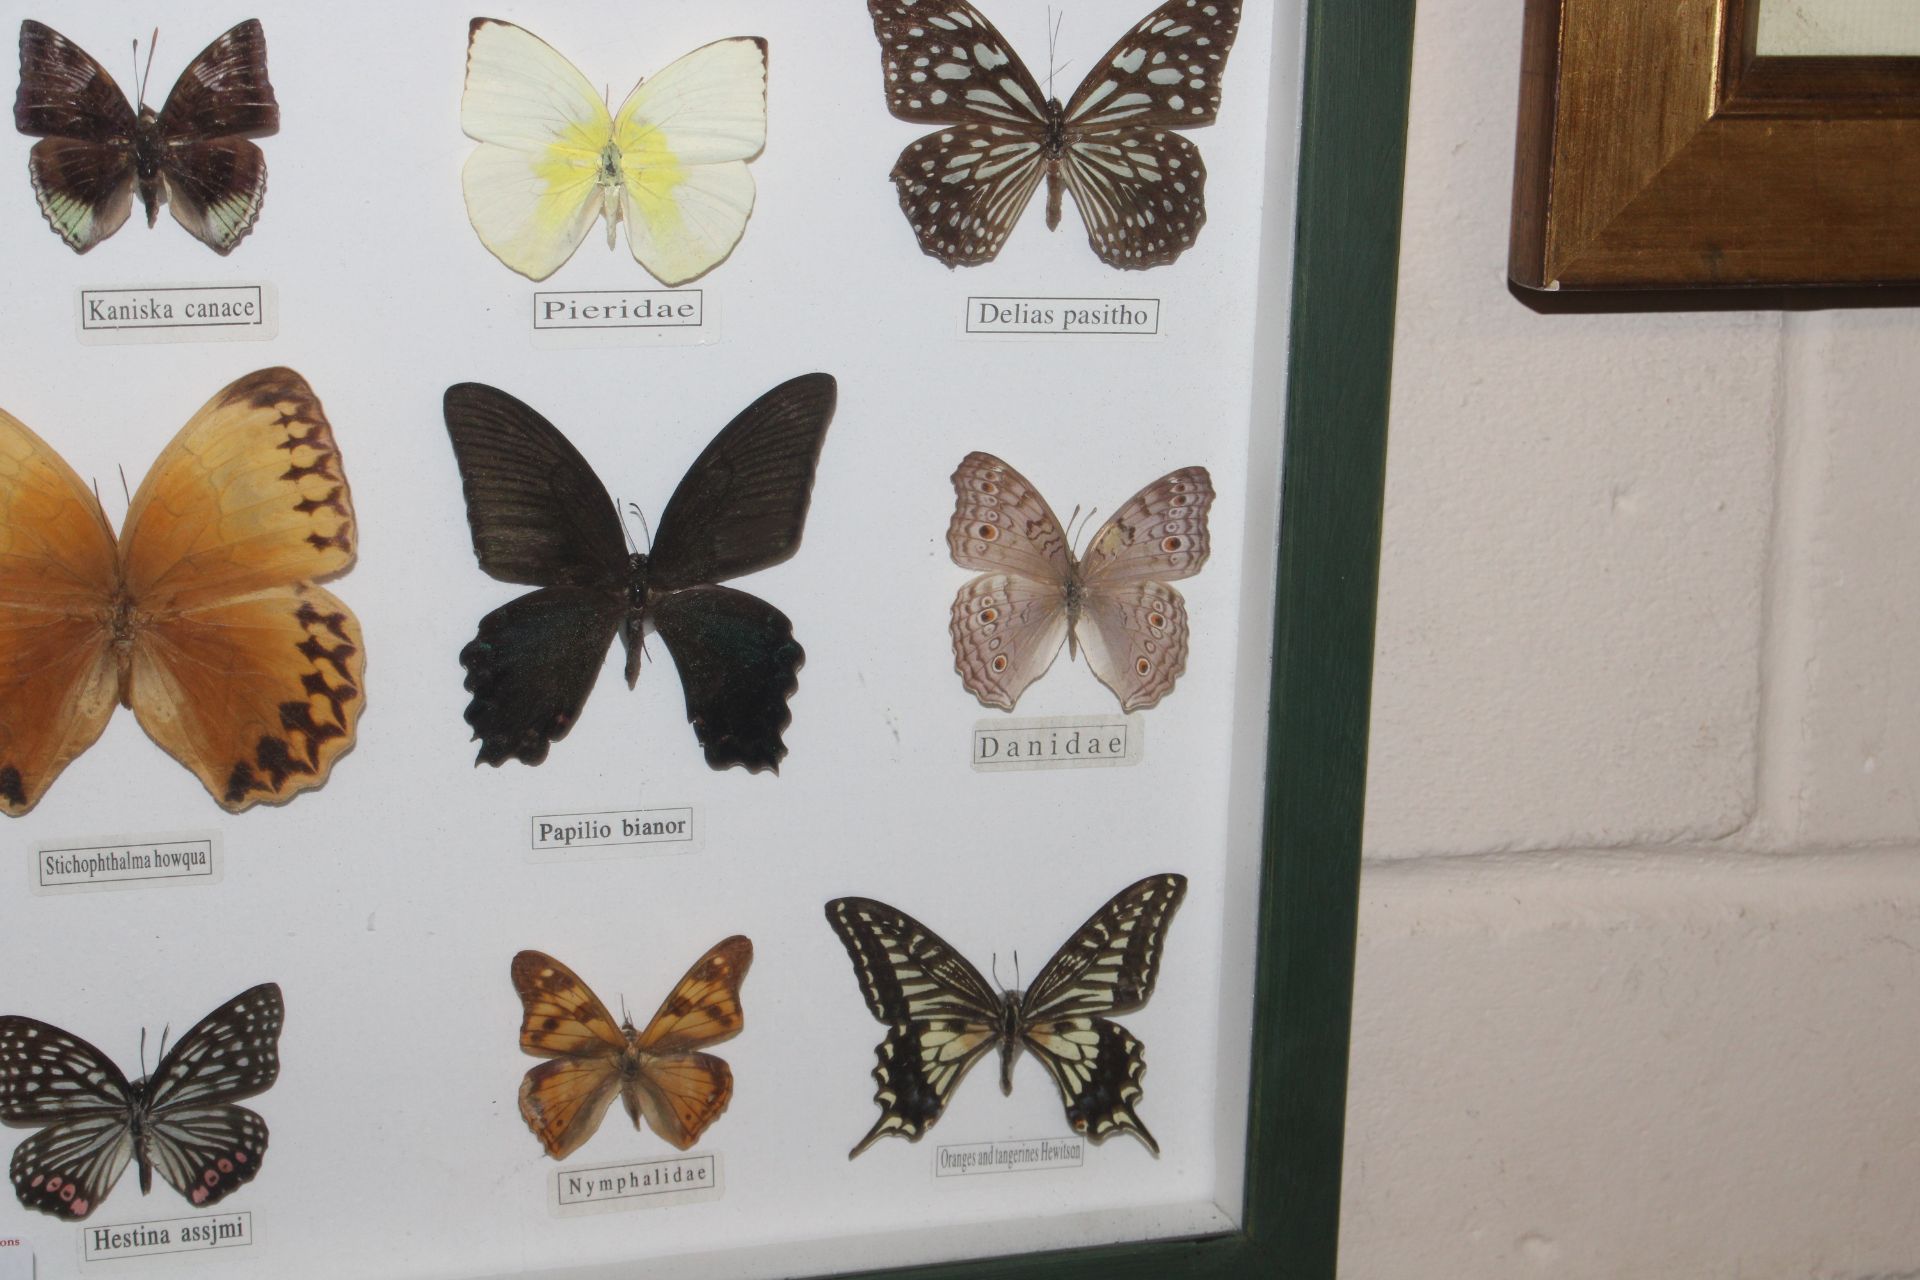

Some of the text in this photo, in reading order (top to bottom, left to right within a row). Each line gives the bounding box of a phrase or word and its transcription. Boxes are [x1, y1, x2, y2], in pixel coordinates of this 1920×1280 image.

[90, 298, 255, 321] Kaniska canace
[543, 299, 695, 320] Pieridae
[979, 303, 1148, 330] Delias pasitho
[980, 732, 1121, 758] Danidae
[539, 818, 686, 845] Papilio bianor
[46, 850, 206, 877] Stichophthalma howqua
[941, 1141, 1080, 1173] Oranges and tangerines Hewitson
[569, 1166, 706, 1197] Nymphalidae
[94, 1216, 243, 1250] Hestina assjmi
